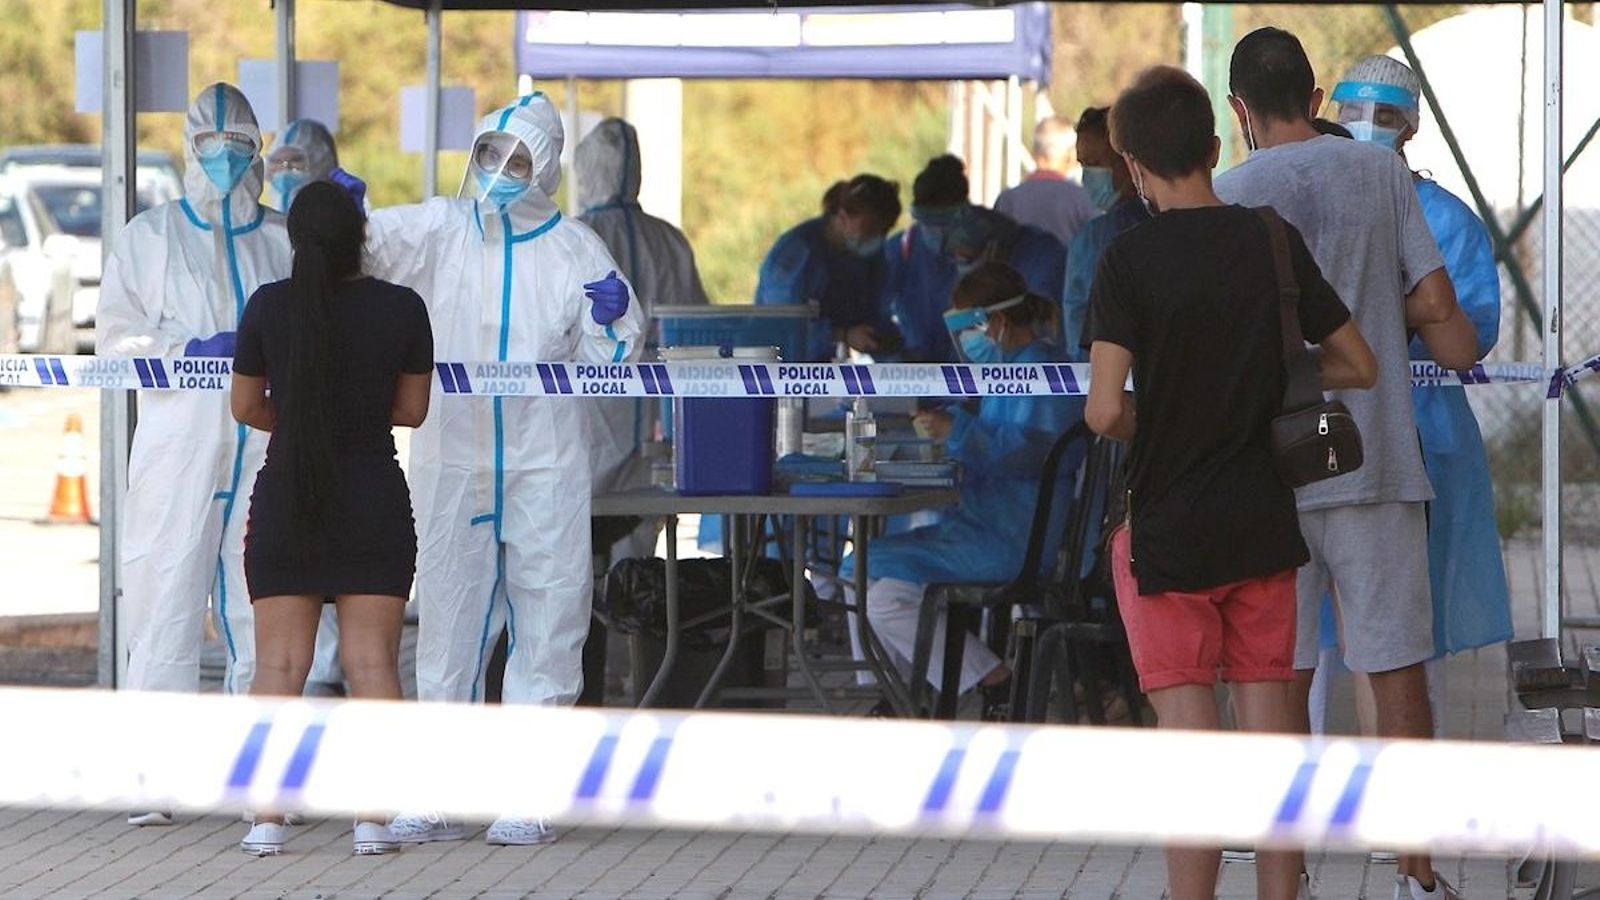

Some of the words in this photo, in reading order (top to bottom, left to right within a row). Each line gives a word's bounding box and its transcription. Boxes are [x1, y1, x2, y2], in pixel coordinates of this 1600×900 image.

[173, 360, 230, 375] POLICIA
[576, 365, 633, 380] POLICIA
[779, 366, 836, 380] POLICIA
[981, 366, 1038, 380] POLICIA
[1409, 364, 1449, 377] LICIA
[179, 376, 224, 389] LOCAL
[582, 382, 627, 394] LOCAL
[784, 382, 829, 395] LOCAL
[987, 383, 1032, 394] LOCAL
